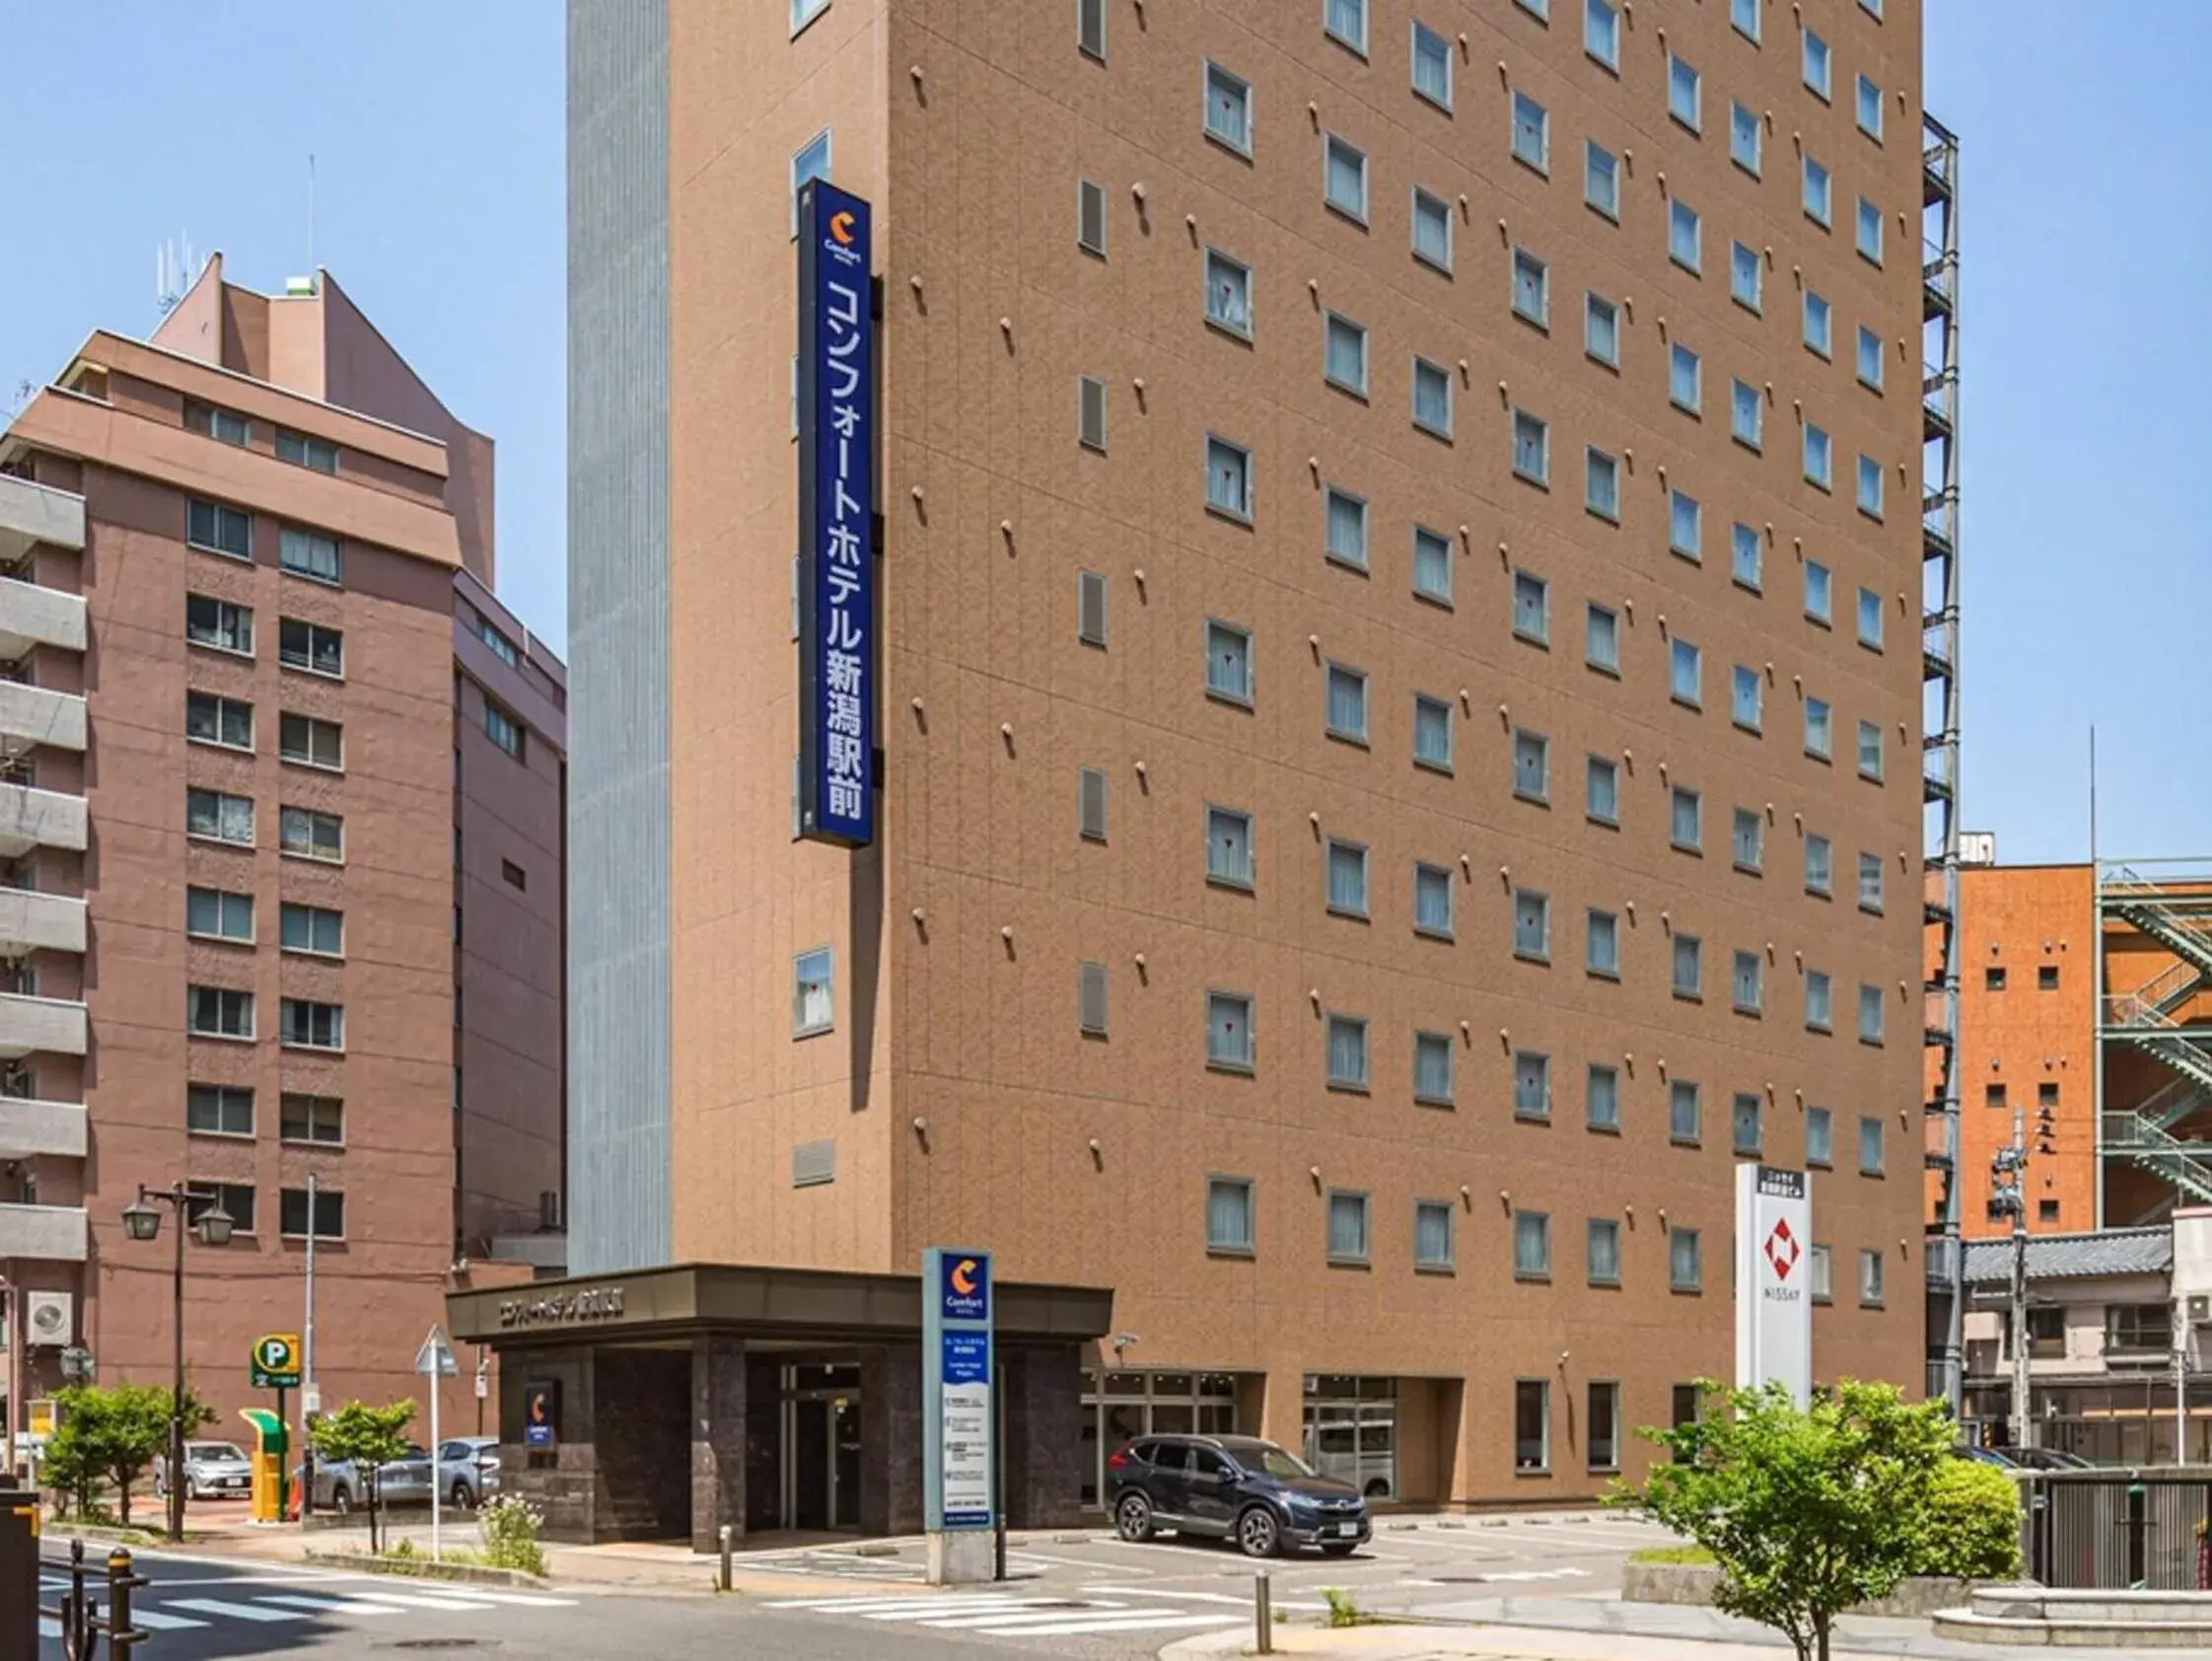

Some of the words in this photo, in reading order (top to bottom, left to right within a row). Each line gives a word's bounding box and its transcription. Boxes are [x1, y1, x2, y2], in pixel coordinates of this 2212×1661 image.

[826, 280, 863, 821] コンフォートホテル新潟駅前
[266, 1341, 286, 1366] P
